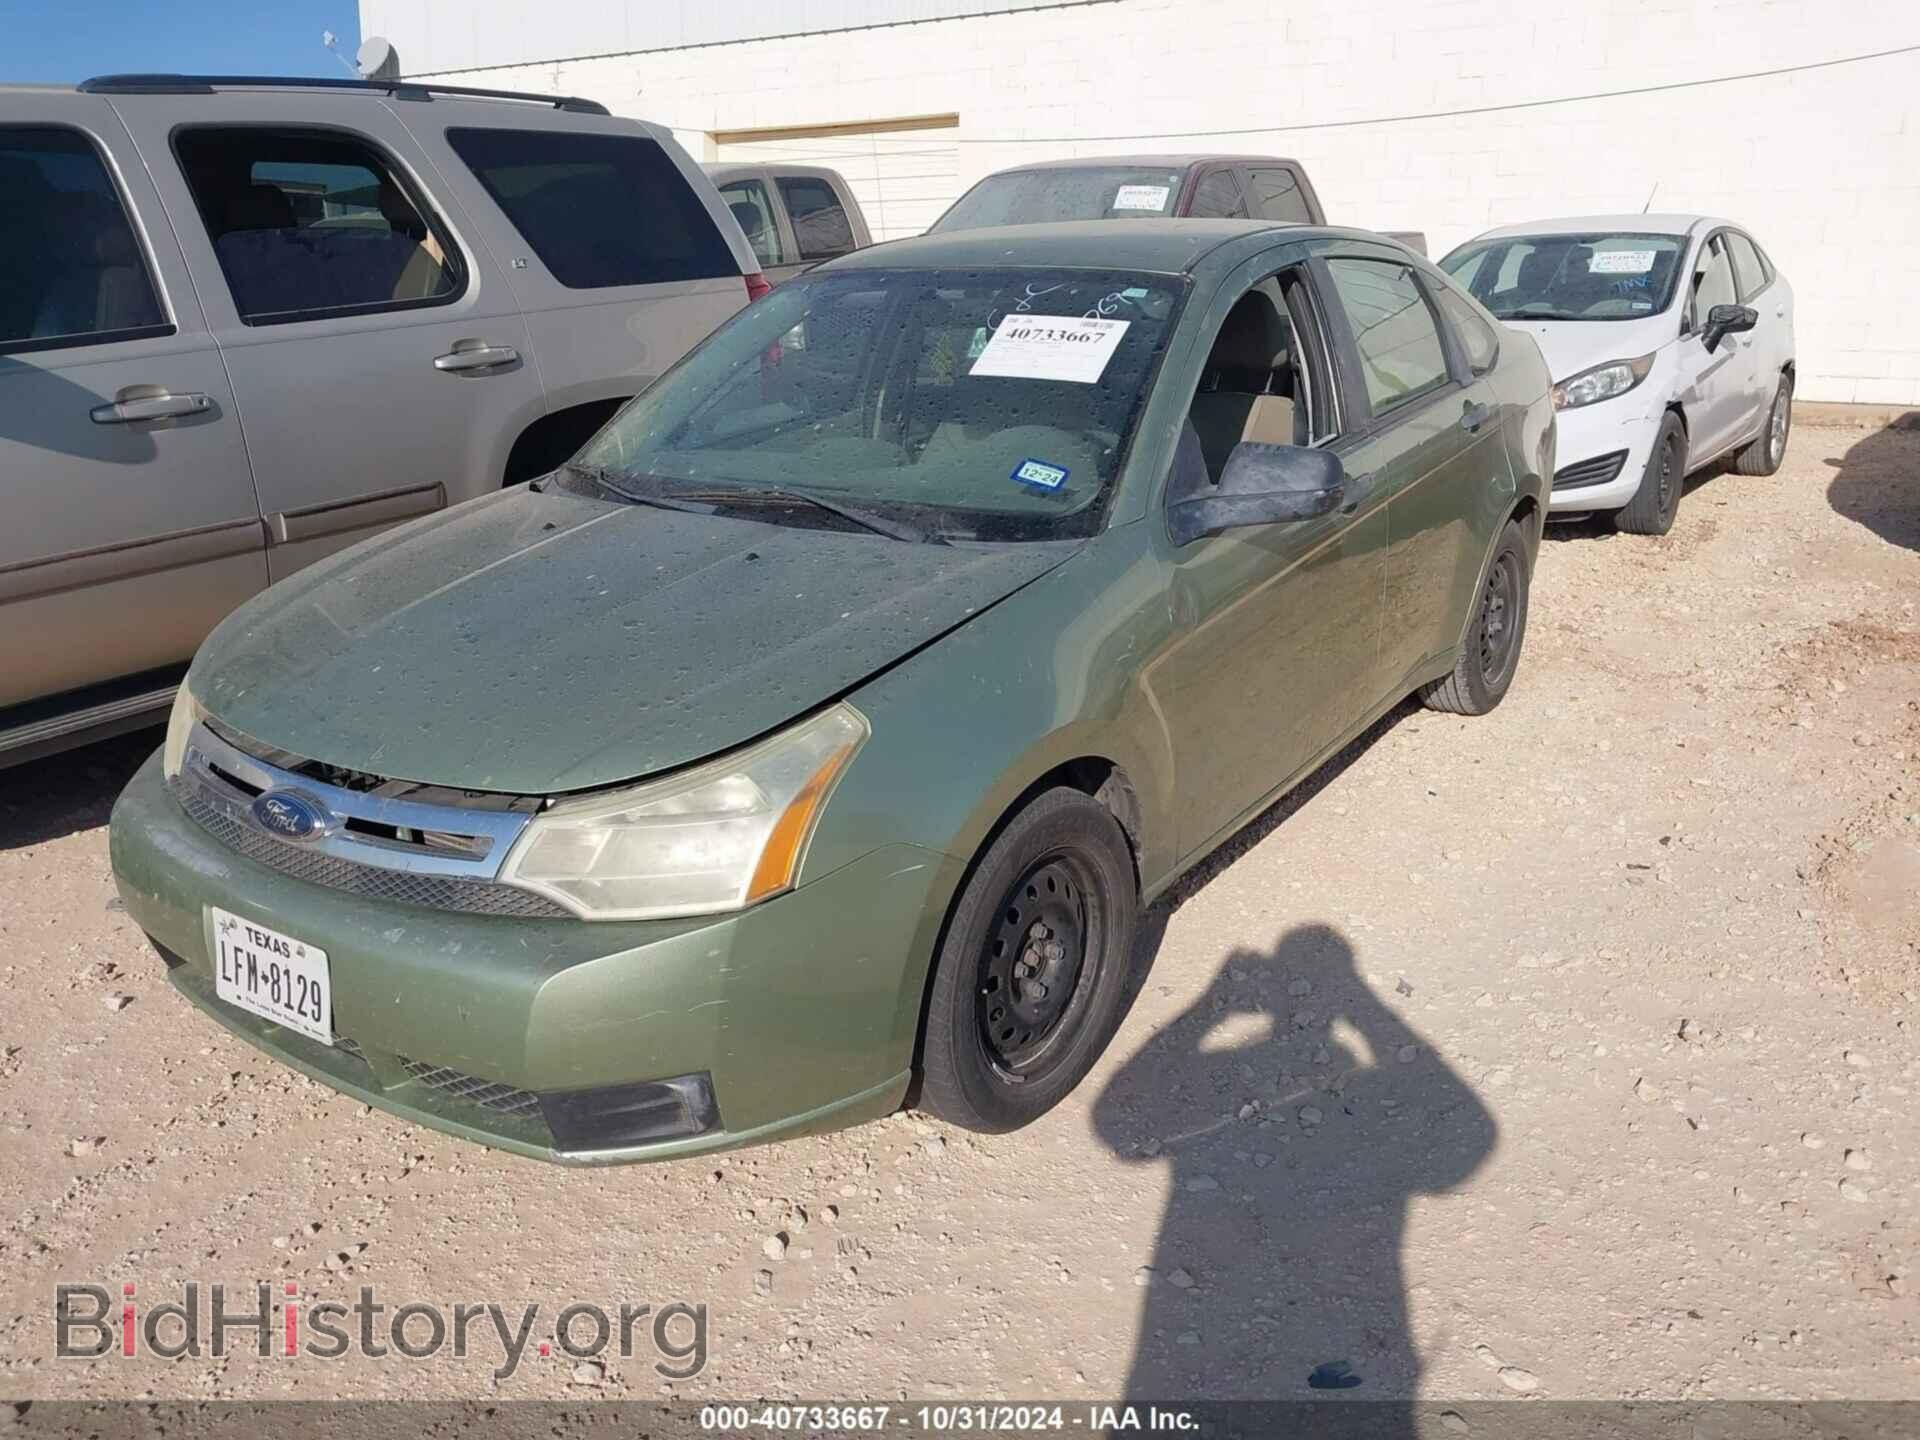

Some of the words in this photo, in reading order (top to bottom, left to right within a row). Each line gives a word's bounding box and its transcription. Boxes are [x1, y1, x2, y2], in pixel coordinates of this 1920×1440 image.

[1006, 327, 1107, 344] 40733667
[260, 799, 299, 832] Ford
[245, 926, 290, 958] TEXAS
